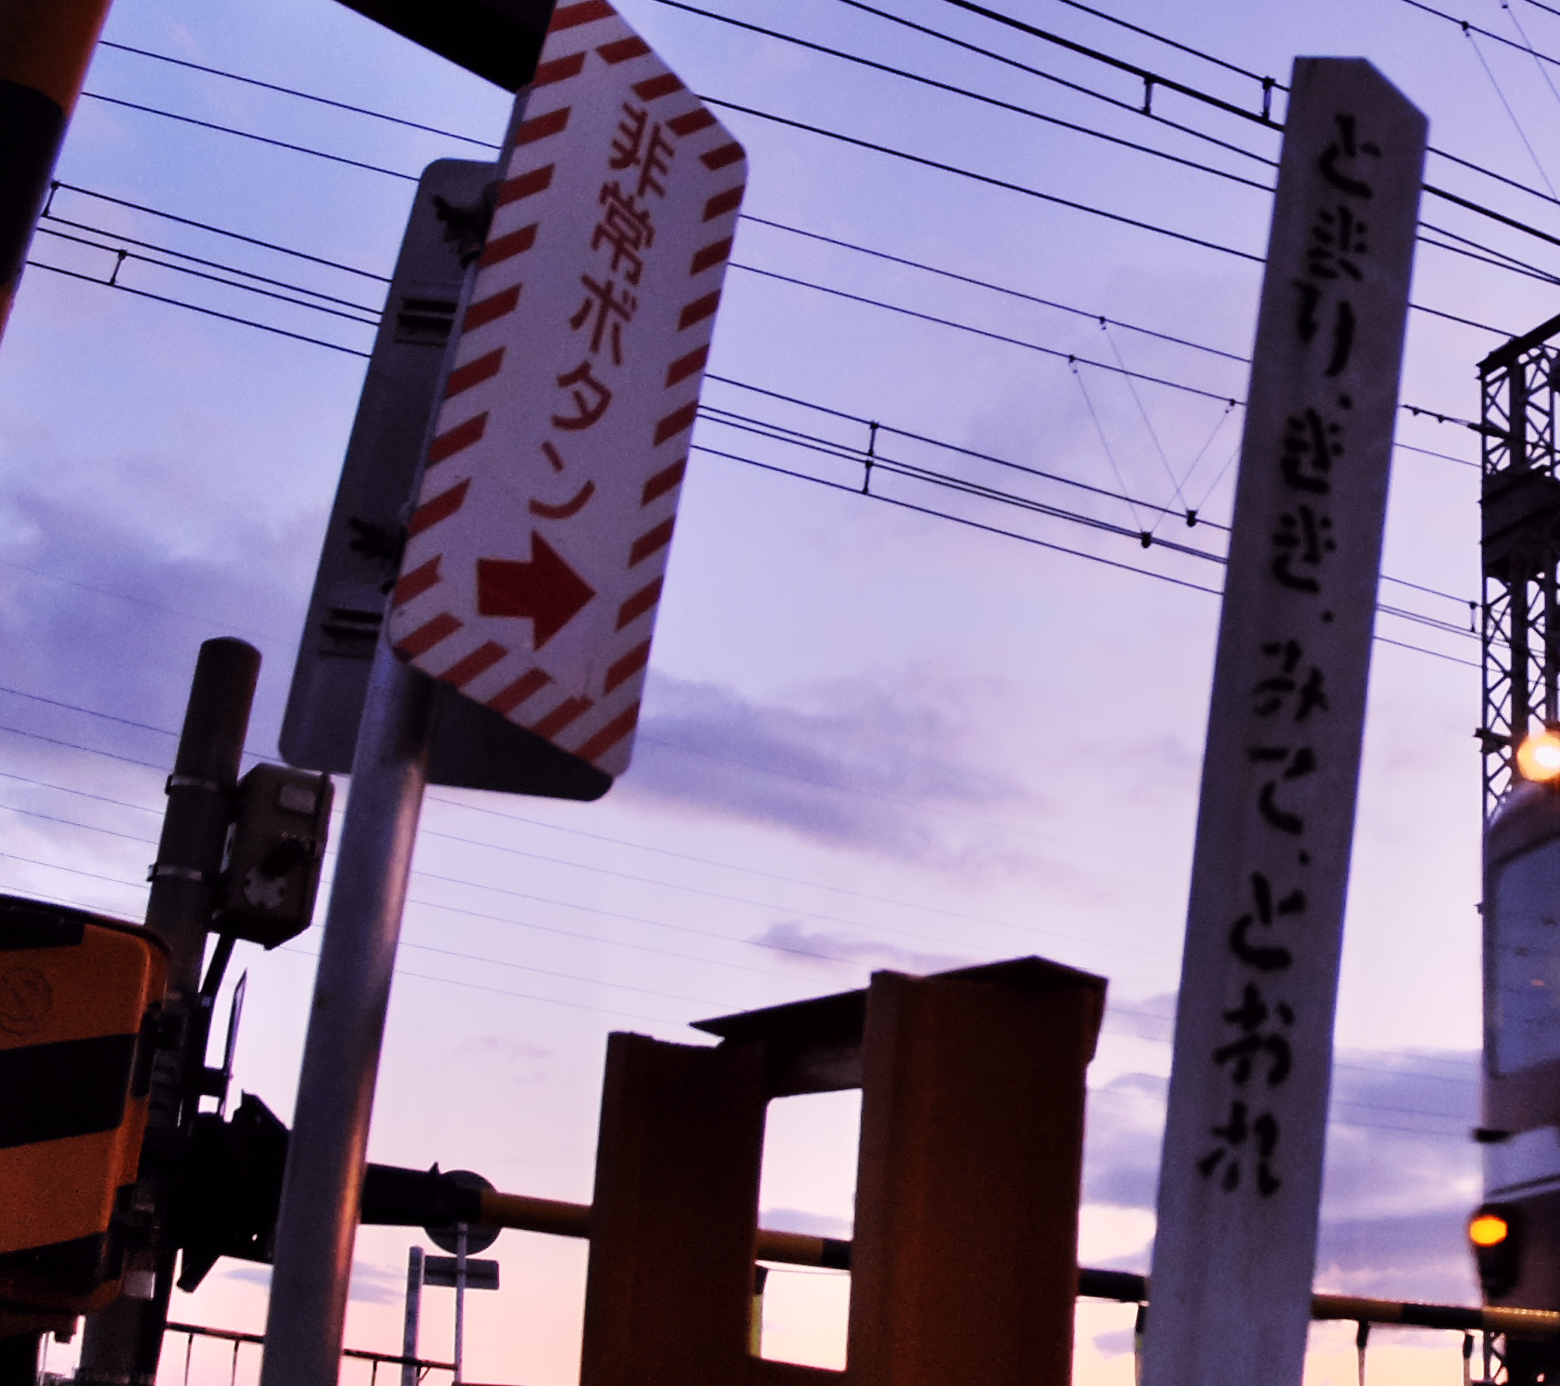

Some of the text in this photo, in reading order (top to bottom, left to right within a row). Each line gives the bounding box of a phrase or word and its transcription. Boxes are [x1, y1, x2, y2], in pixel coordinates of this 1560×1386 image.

[529, 101, 675, 519] 非常ボタン
